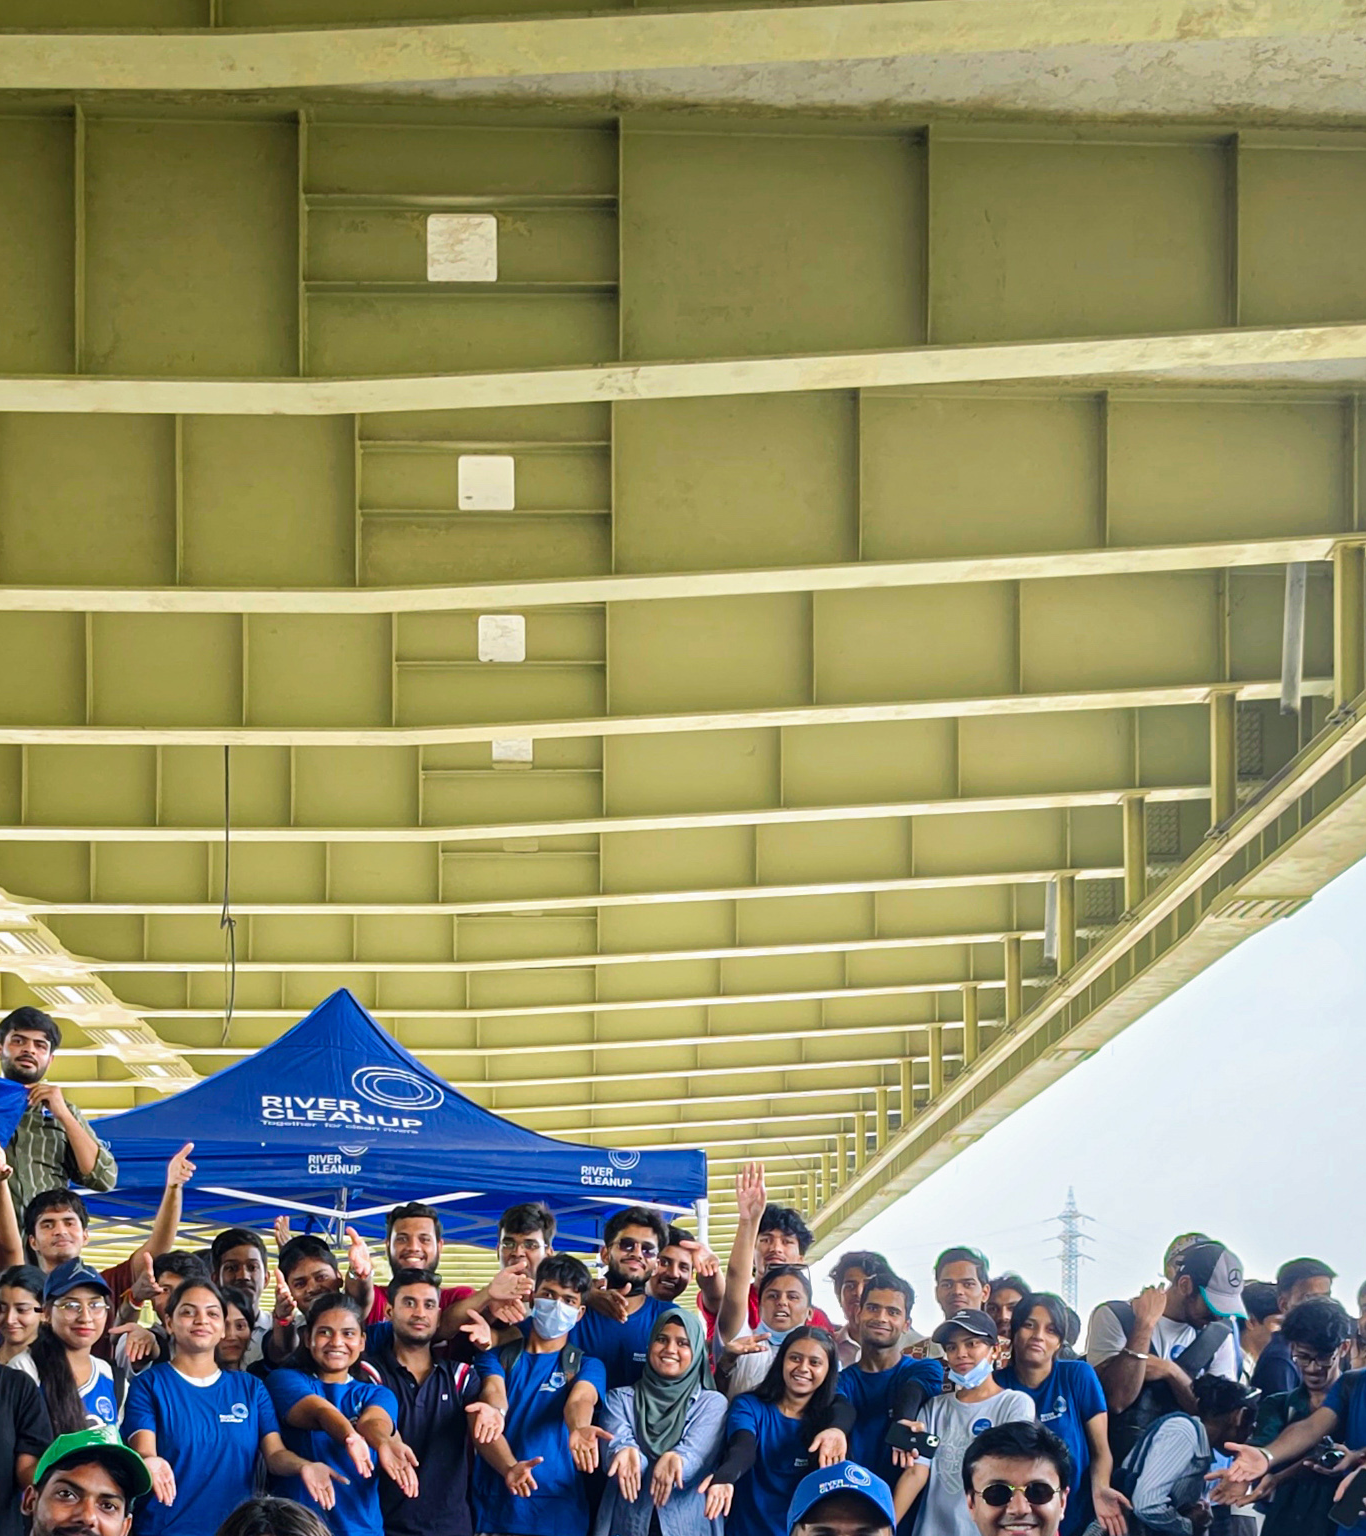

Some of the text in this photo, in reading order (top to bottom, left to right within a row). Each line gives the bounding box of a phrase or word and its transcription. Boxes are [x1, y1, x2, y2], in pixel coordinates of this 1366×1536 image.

[261, 1095, 361, 1113] RIVER
[261, 1108, 423, 1128] CLEANUP
[308, 1154, 342, 1165] RIVER
[308, 1164, 361, 1176] CLEANUP
[580, 1165, 613, 1177] RIVER
[580, 1175, 633, 1188] CLEANUP
